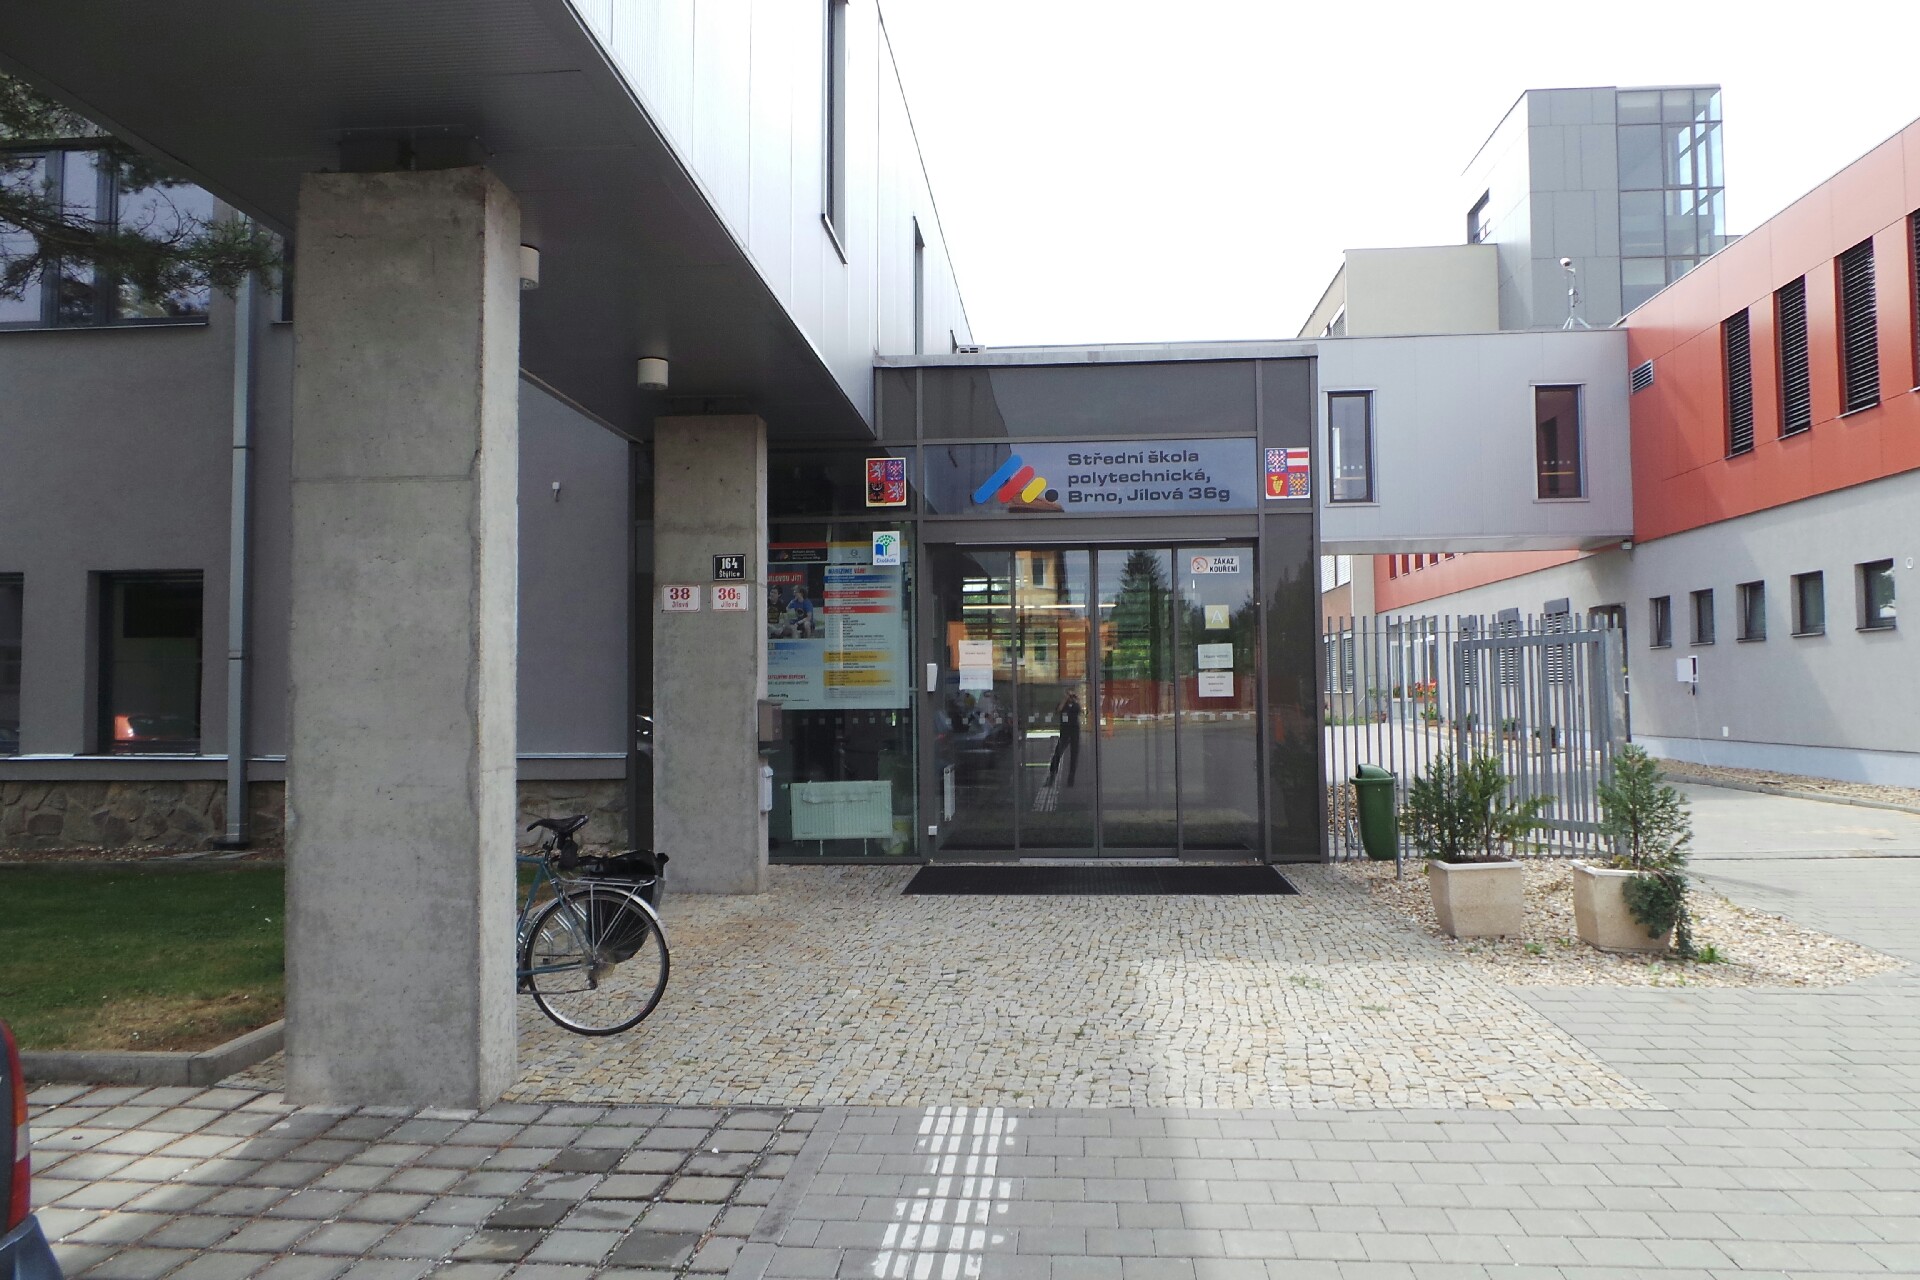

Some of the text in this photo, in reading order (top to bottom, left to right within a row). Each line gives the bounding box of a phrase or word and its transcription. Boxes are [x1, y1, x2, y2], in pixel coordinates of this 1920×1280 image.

[1068, 450, 1199, 466] Střední škola
[1068, 468, 1211, 487] polytechnická,
[1068, 487, 1230, 504] Brno, Jílová 36g
[721, 557, 738, 570] 164
[669, 587, 690, 600] 38
[1211, 610, 1224, 624] A
